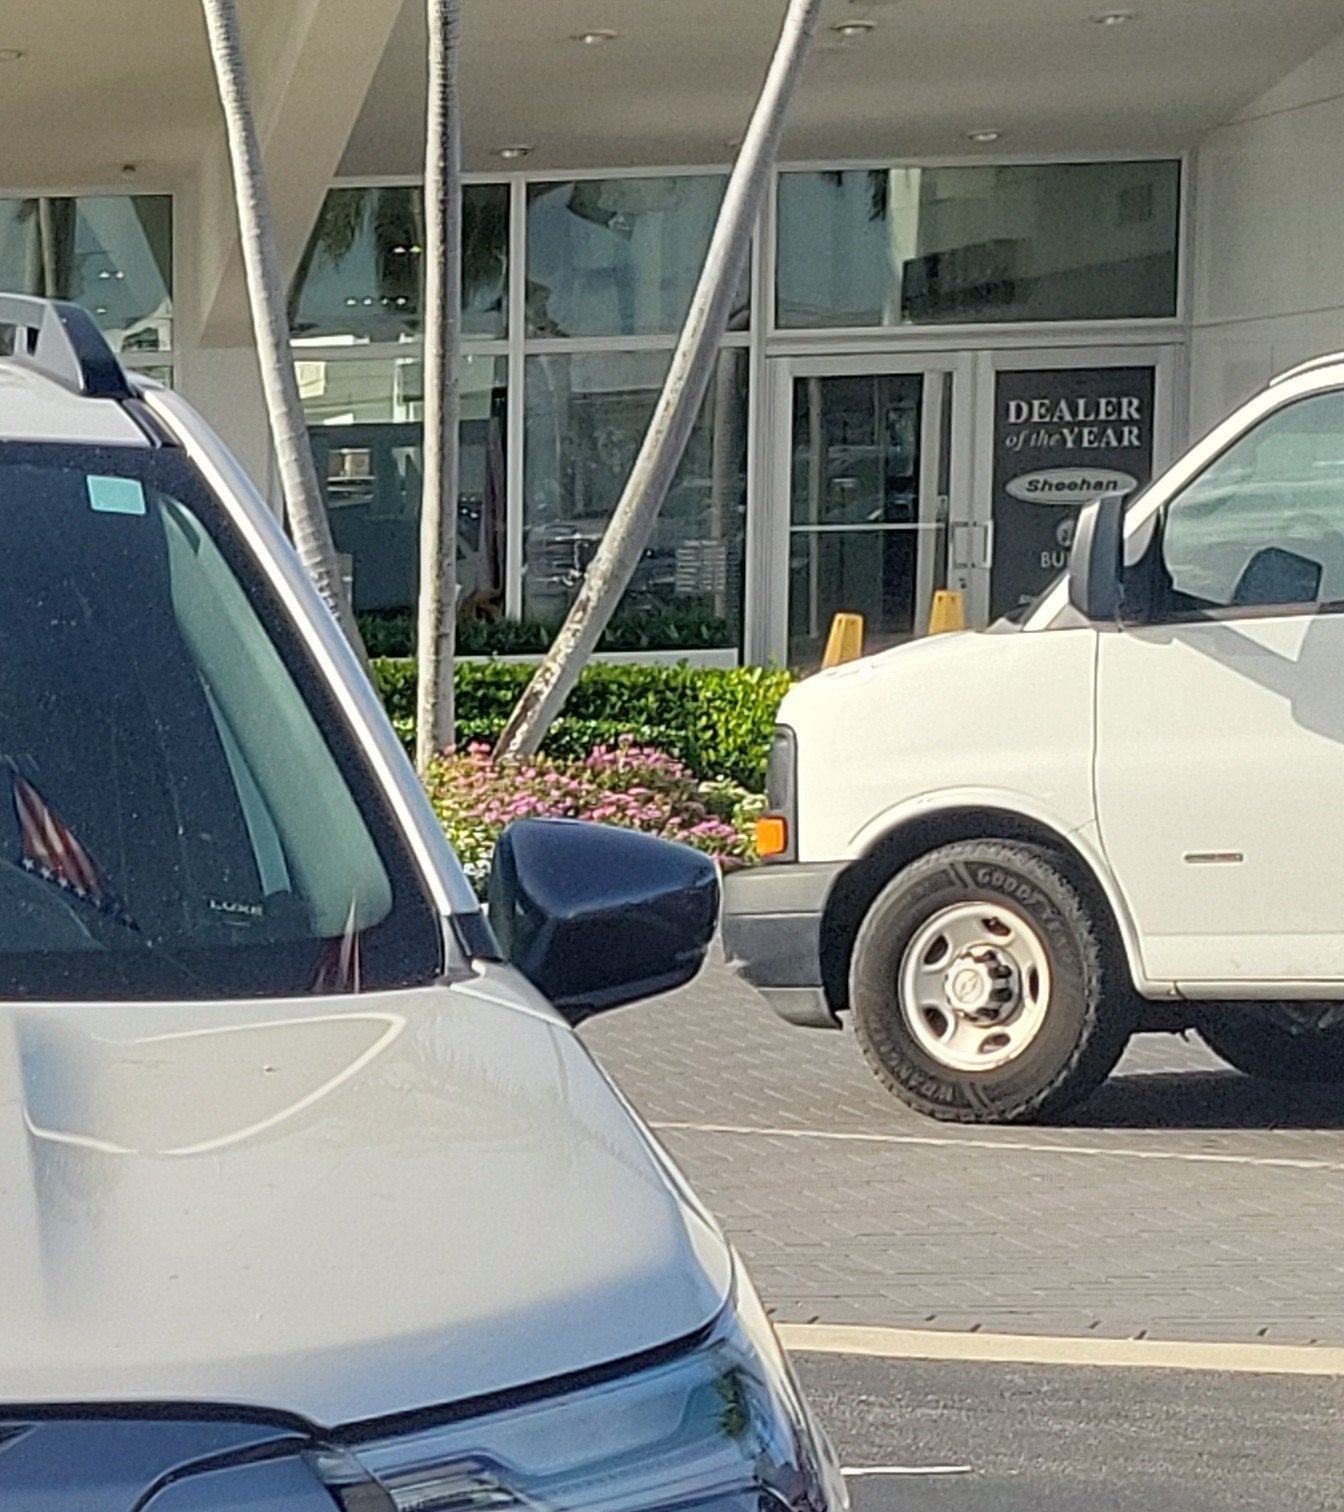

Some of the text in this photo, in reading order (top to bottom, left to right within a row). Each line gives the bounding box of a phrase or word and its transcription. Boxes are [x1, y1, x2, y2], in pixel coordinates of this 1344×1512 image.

[1008, 397, 1141, 423] DEALER
[1005, 425, 1141, 452] of the YEAR
[1026, 479, 1118, 493] Sheehan
